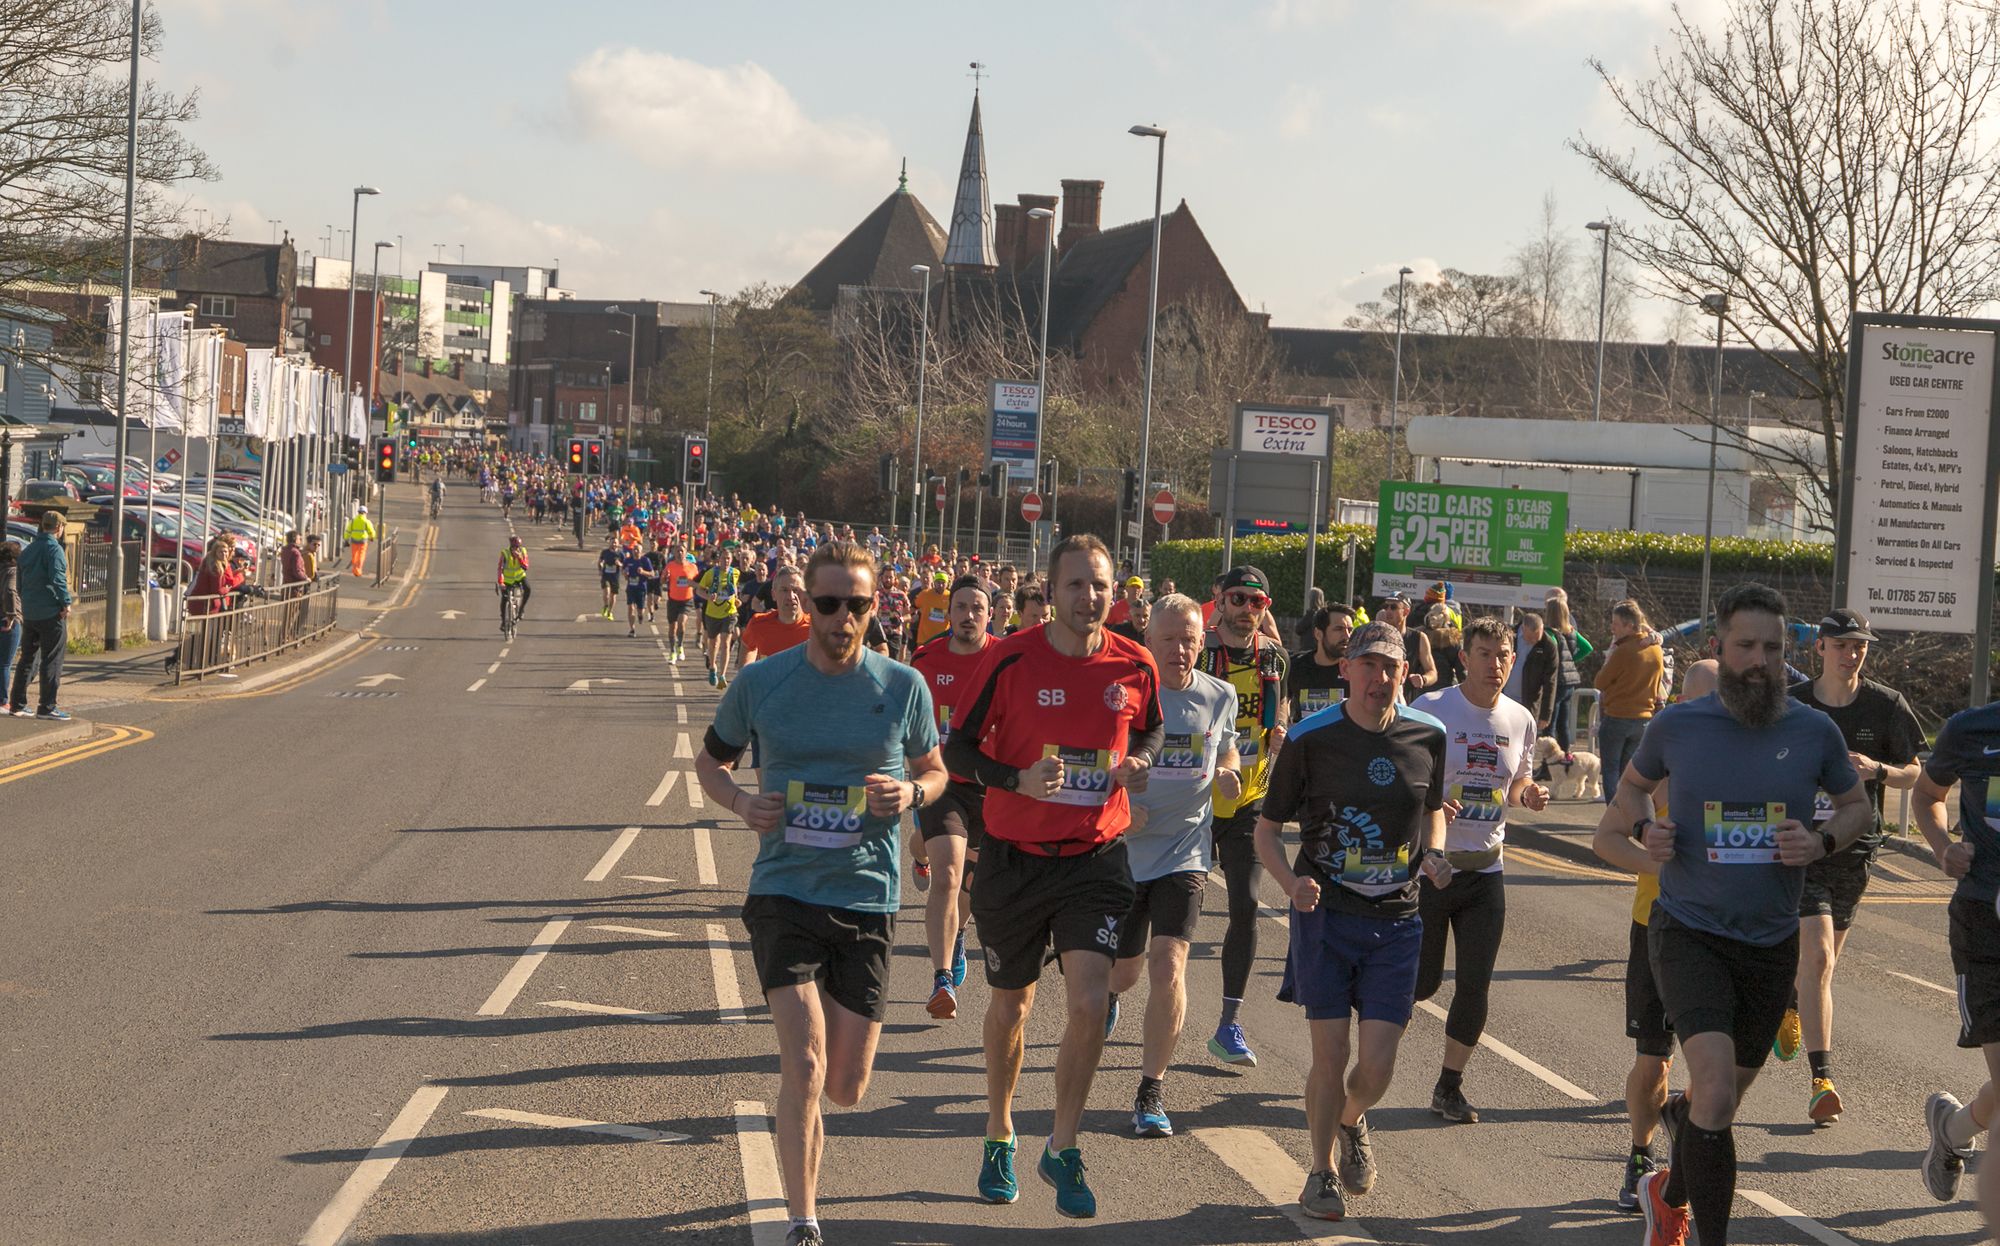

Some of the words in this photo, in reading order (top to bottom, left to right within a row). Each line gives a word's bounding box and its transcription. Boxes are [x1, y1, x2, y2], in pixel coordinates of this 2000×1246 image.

[1882, 342, 1975, 366] Stoneacre
[1890, 375, 1911, 387] USED
[1913, 377, 1929, 388] CAR
[1931, 378, 1964, 390] CENTRE
[1003, 386, 1035, 395] TESCO
[1006, 398, 1030, 407] extra
[1886, 406, 1903, 417] Cars
[1905, 407, 1925, 418] From
[1926, 408, 1950, 419] £2000
[996, 418, 1006, 427] 24
[1007, 419, 1027, 429] hours
[1254, 415, 1316, 430] TESCO
[1884, 425, 1912, 437] Finance
[1914, 427, 1950, 440] Arranged
[1263, 436, 1306, 451] extra
[1883, 445, 1914, 457] Saloons,
[1916, 447, 1958, 458] Hatchbacks
[1882, 460, 1912, 472] Estates,
[1913, 462, 1936, 474] 4x4's,
[1938, 463, 1962, 474] MPV's
[1881, 479, 1906, 491] Petrol,
[1908, 481, 1932, 493] Diesel,
[1934, 482, 1960, 493] Hybrid
[1393, 491, 1440, 514] USED
[1445, 494, 1493, 517] CARS
[1506, 498, 1513, 513] 5
[1516, 499, 1552, 515] YEARS
[1879, 499, 1920, 510] Automatics
[1922, 500, 1929, 511] &
[1931, 501, 1963, 513] Manuals
[1450, 517, 1489, 546] PER
[1878, 517, 1888, 528] All
[1890, 518, 1945, 531] Manufacturers
[1389, 514, 1450, 564] £25
[1519, 538, 1535, 551] NIL
[1877, 536, 1919, 549] Warranties
[1920, 539, 1930, 549] On
[1932, 539, 1942, 550] All
[1943, 540, 1961, 551] Cars
[1451, 545, 1492, 567] WEEK
[1875, 555, 1908, 567] Serviced
[1910, 558, 1917, 567] &
[1918, 558, 1954, 570] Inspected
[1381, 579, 1418, 590] Stoneacre
[1868, 587, 1884, 601] Tel.
[1887, 588, 1916, 603] 01785
[1918, 590, 1936, 604] 257
[1938, 592, 1957, 605] 565
[1869, 605, 1952, 618] www.stoneacre.co.uk
[936, 673, 955, 686] RP
[1038, 688, 1066, 707] SB
[1303, 699, 1336, 711] 112
[1157, 748, 1193, 767] 142
[792, 802, 861, 831] 2896
[1713, 823, 1778, 847] 1695
[1363, 865, 1394, 884] 24
[1096, 927, 1119, 950] SB
